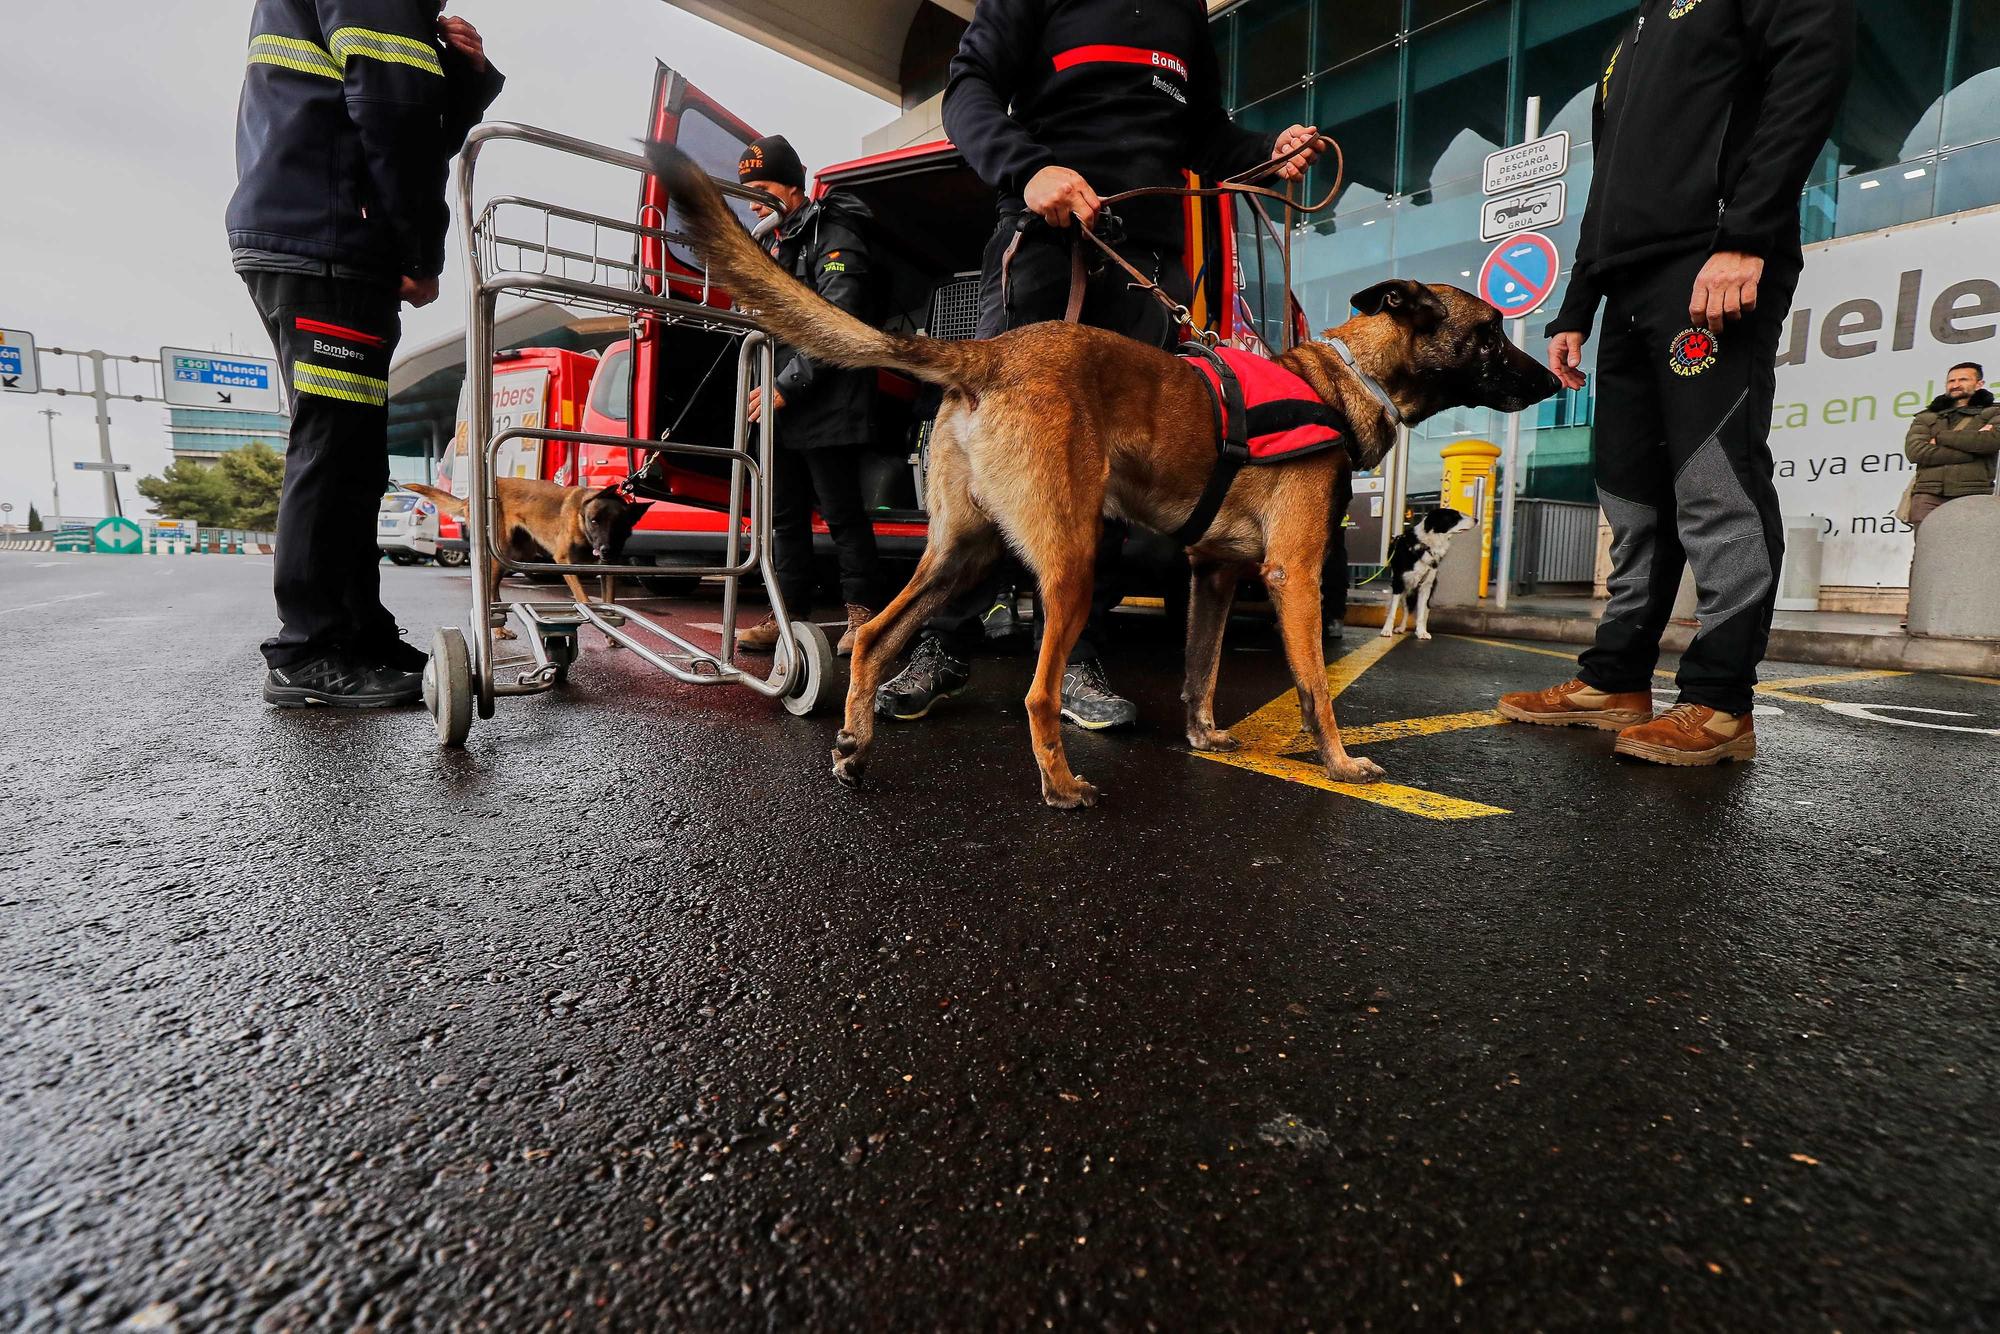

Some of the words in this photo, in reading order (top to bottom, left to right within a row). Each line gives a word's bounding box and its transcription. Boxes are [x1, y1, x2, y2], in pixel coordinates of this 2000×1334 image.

[1499, 154, 1550, 175] DESCARGA
[1504, 144, 1546, 163] EXCEPTO
[1490, 179, 1502, 188] DE
[1504, 161, 1559, 183] PASAJEROS
[313, 339, 365, 361] Bombers
[176, 359, 208, 369] E-901
[212, 361, 267, 377] Valencia
[178, 371, 198, 380] A-3
[212, 374, 258, 387] Madrid
[1822, 394, 1877, 425] en
[1807, 456, 1847, 482] ya
[1851, 509, 1914, 534] más
